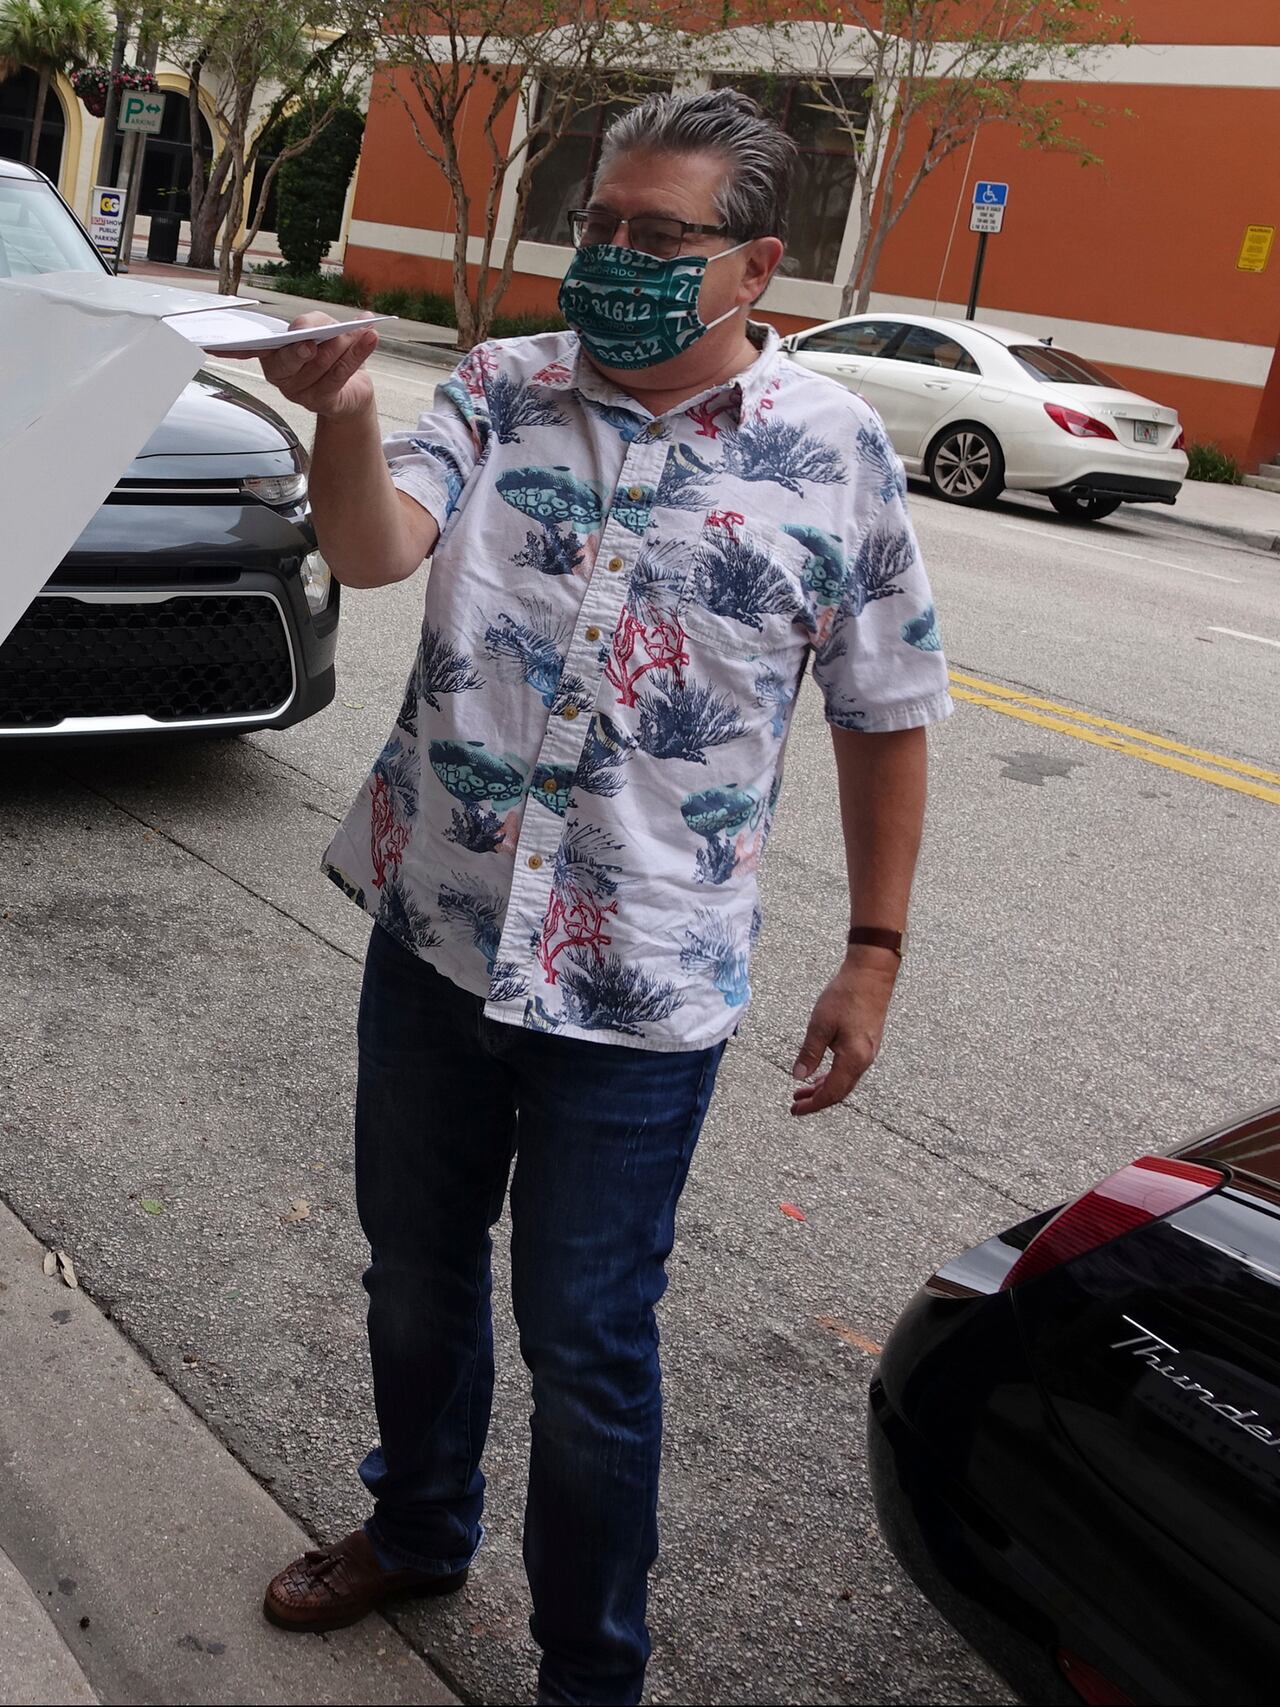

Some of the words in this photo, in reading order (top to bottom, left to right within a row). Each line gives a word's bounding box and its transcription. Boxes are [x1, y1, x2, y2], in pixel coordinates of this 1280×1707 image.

[99, 226, 117, 234] PUBLIC
[591, 298, 651, 322] 81612
[1109, 1313, 1280, 1453] Thunde
